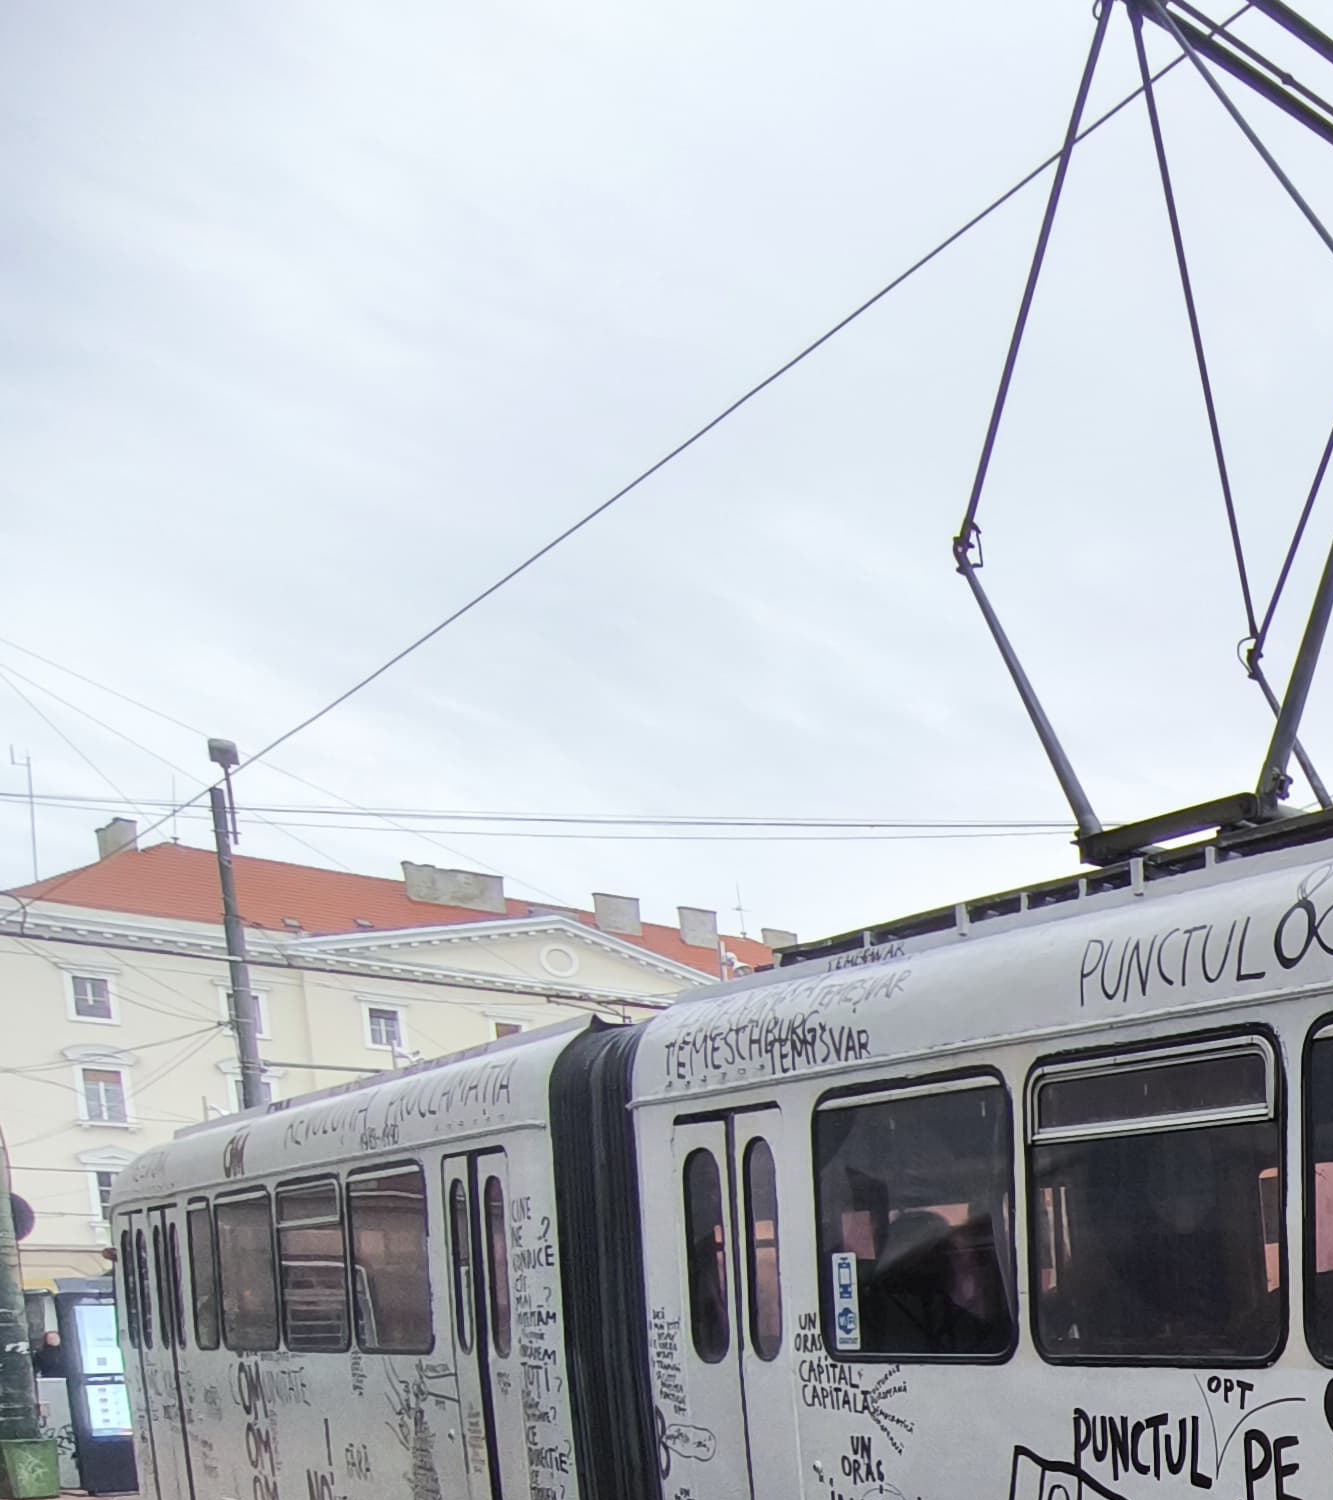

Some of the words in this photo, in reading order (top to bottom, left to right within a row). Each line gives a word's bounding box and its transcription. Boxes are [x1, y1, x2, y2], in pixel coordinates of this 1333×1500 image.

[1079, 916, 1267, 1006] PUNCTUL
[799, 1312, 816, 1330] UN
[1207, 1375, 1254, 1409] OPT
[850, 1435, 872, 1458] UN
[1073, 1408, 1212, 1489] PUNCTUL
